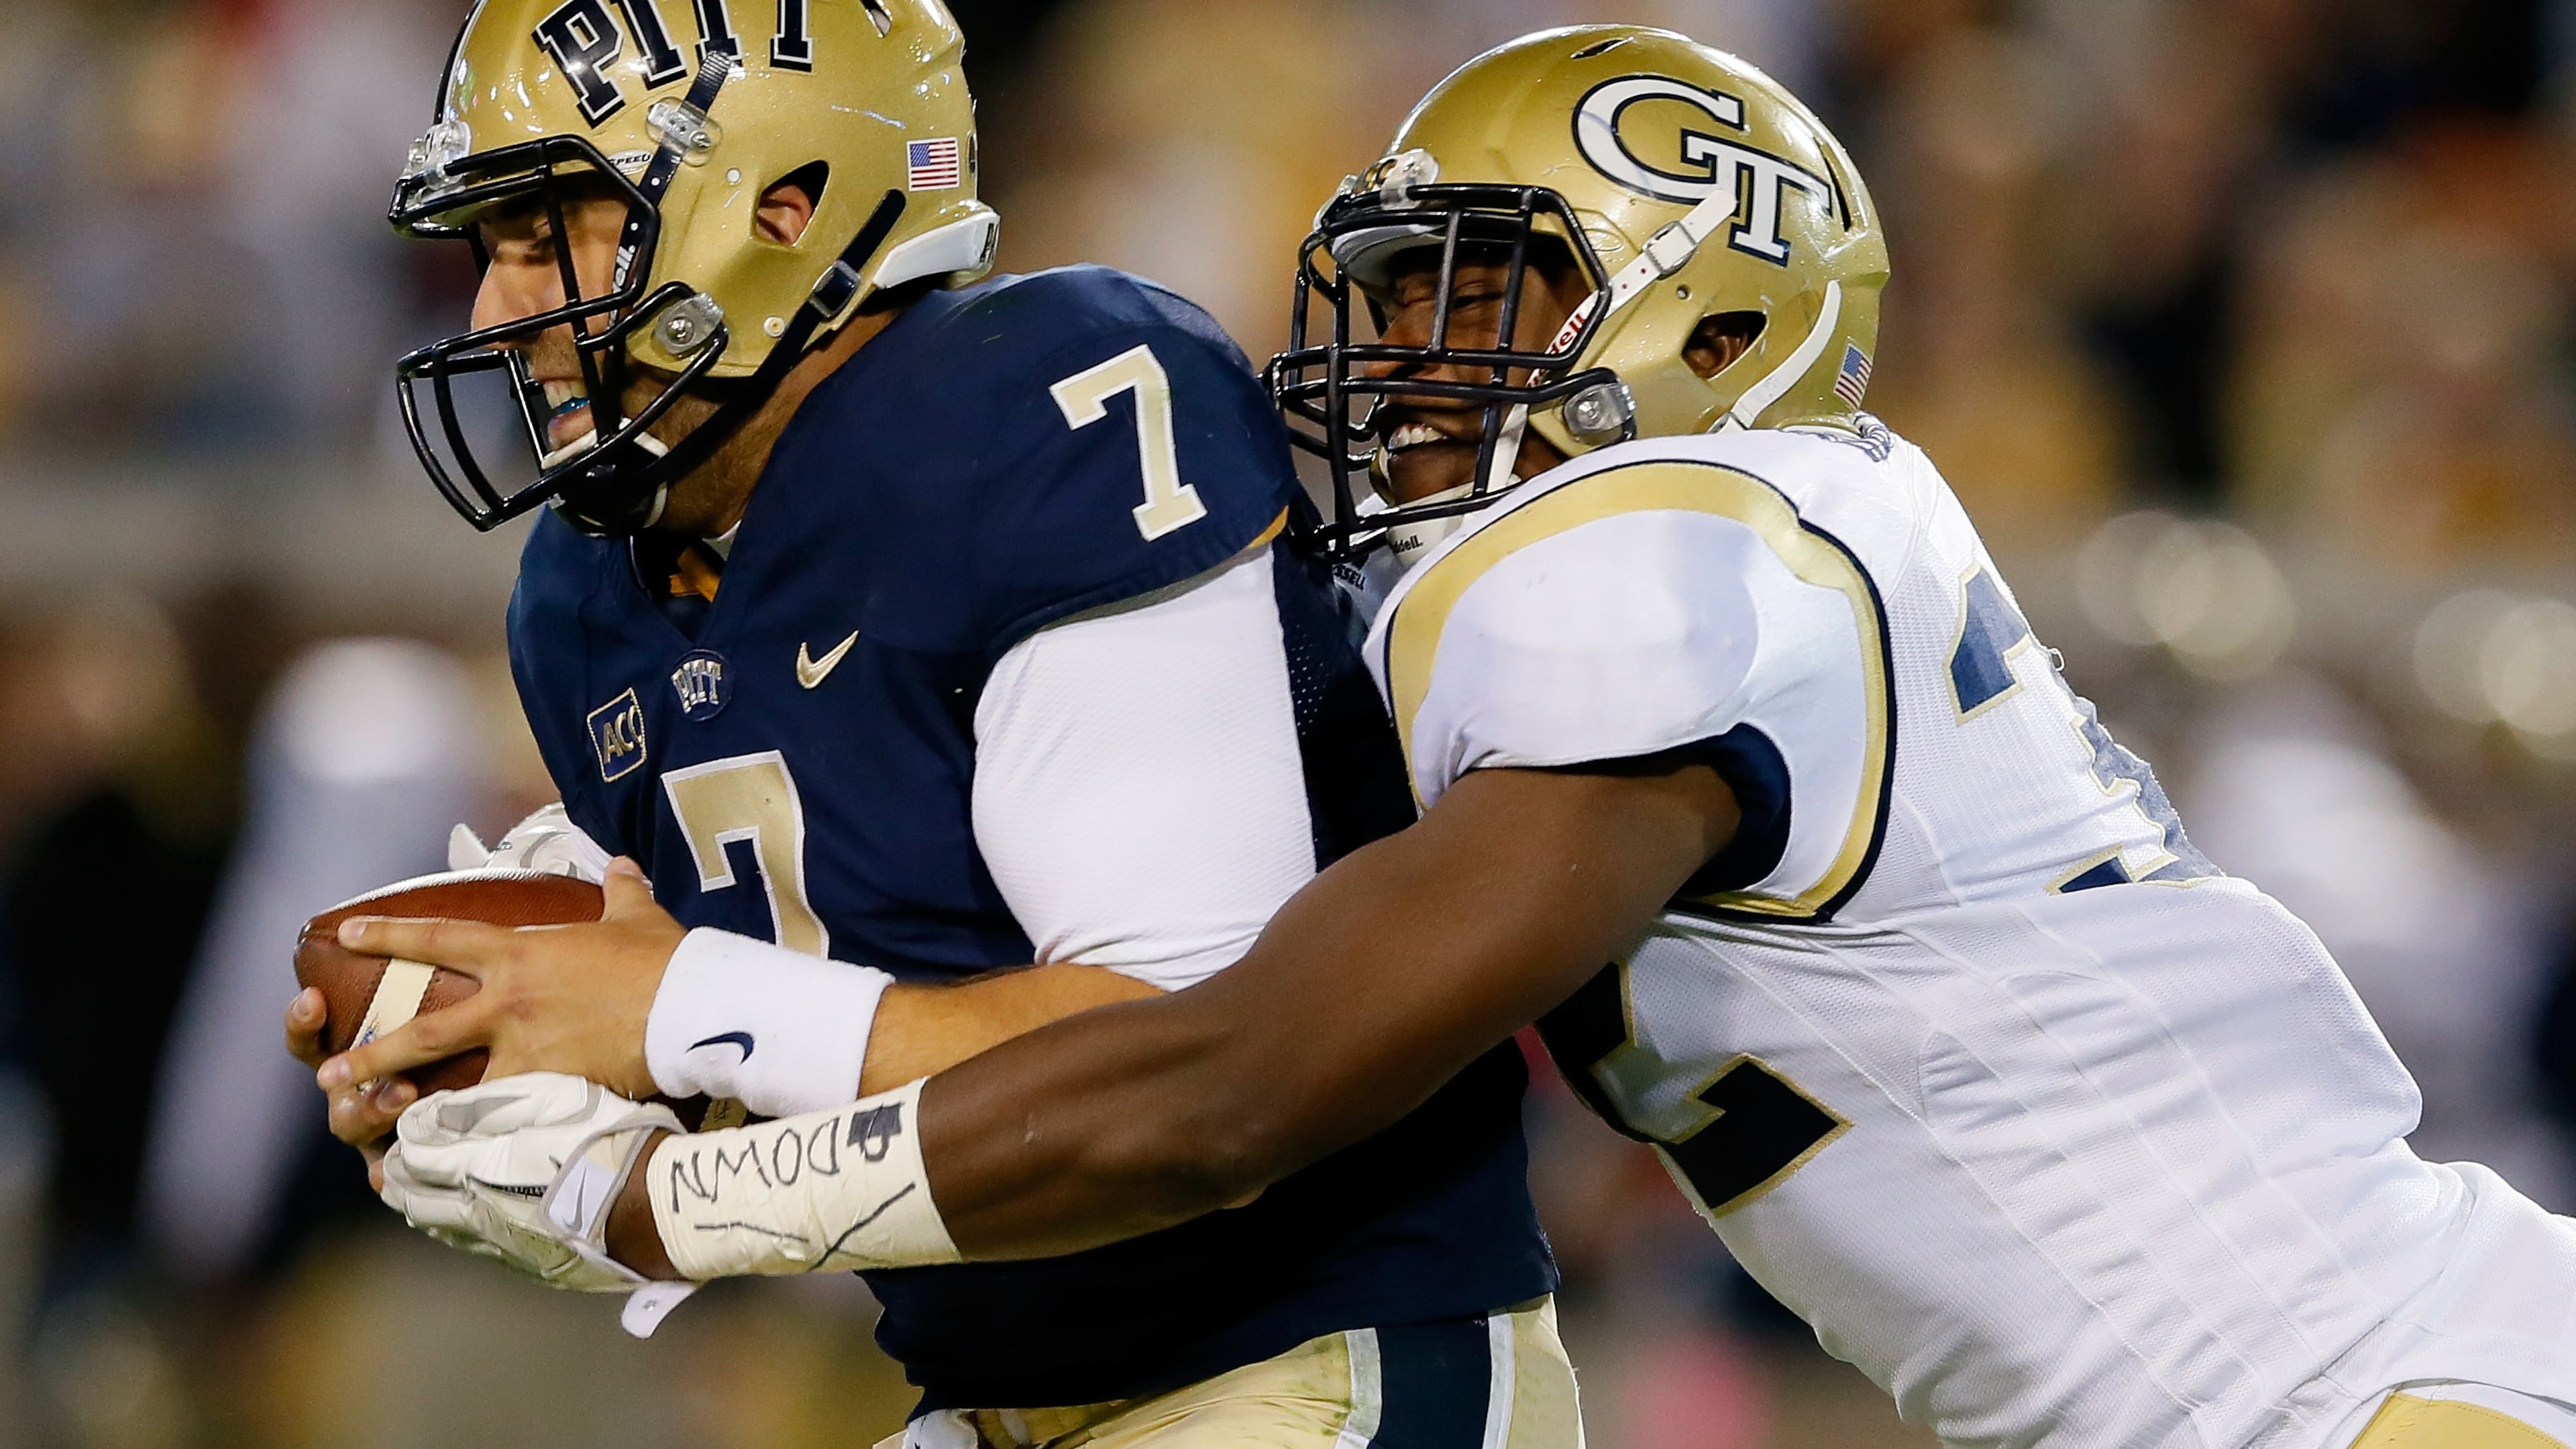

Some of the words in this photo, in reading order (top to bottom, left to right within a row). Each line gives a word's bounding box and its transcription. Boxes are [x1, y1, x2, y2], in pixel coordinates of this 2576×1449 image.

[1572, 74, 1834, 266] GT
[1049, 343, 1208, 543] 7
[604, 704, 642, 765] ACC
[671, 658, 722, 714] PITT
[661, 749, 830, 960] 7
[670, 1116, 840, 1214] DOWN
